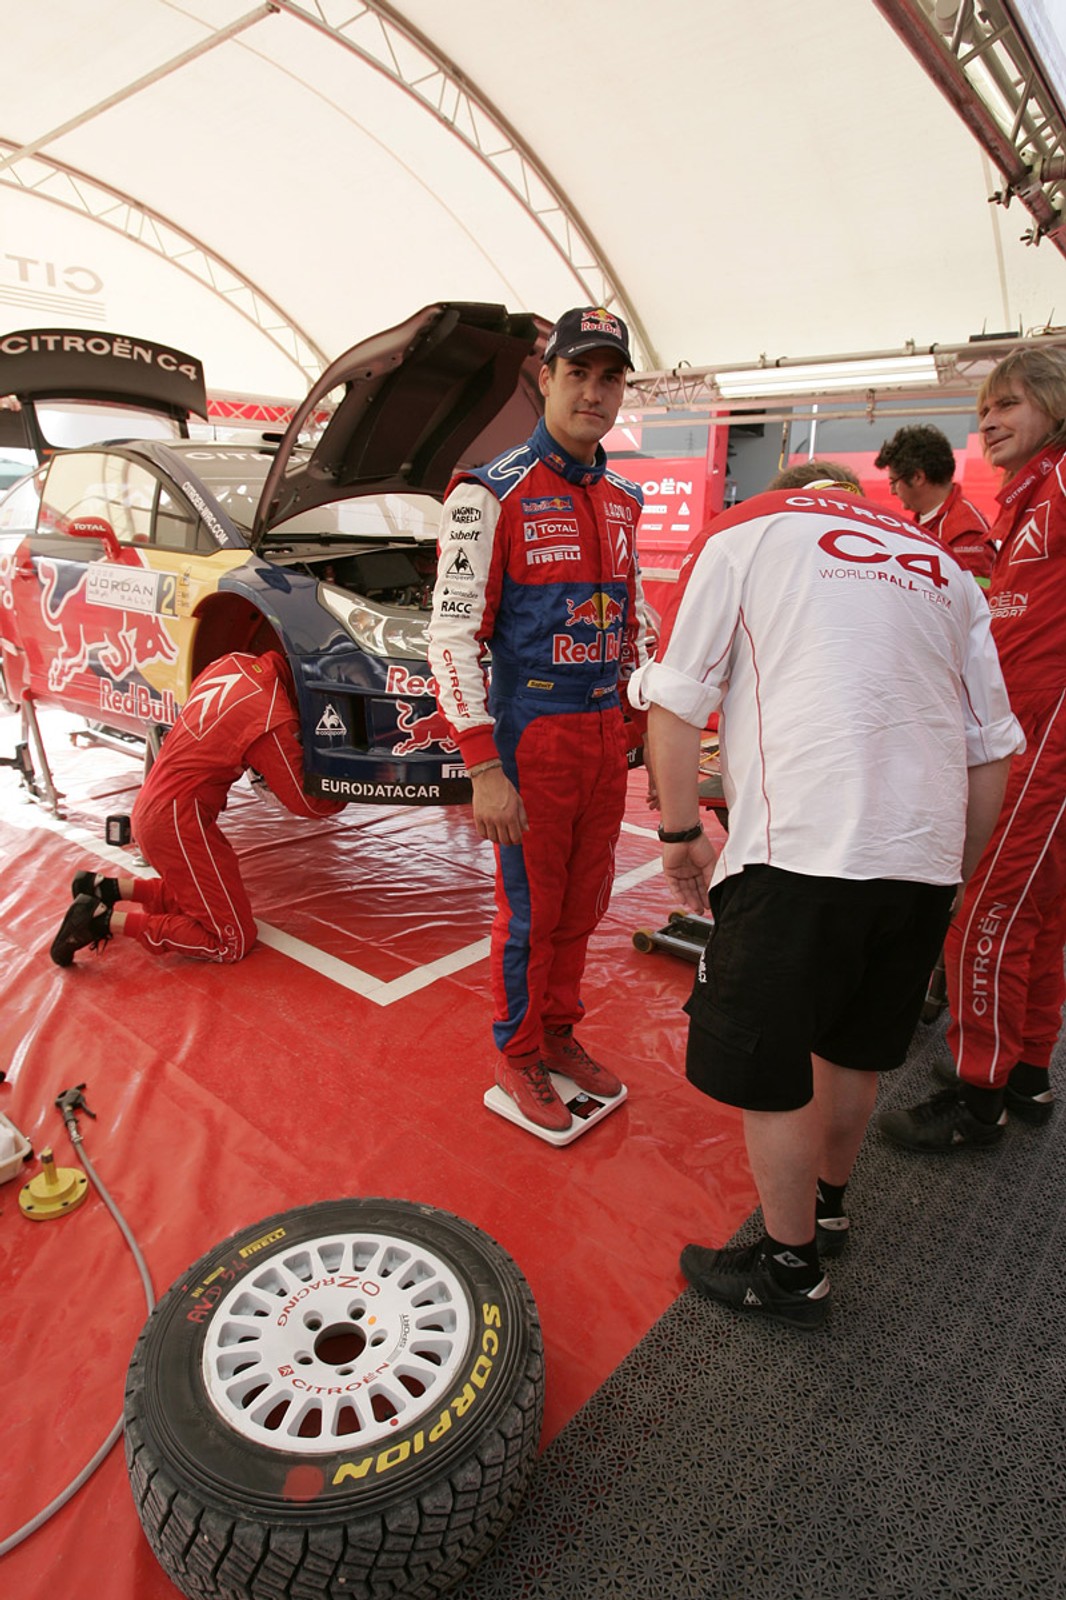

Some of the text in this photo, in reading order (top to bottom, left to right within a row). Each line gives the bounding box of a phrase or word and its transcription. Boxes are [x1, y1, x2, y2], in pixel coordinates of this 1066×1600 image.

[582, 321, 602, 331] Red
[1, 335, 197, 381] CITROËN C4
[74, 523, 106, 532] TOTAL
[537, 523, 577, 534] TOTAL
[526, 545, 581, 566] PIRELLI
[817, 529, 949, 589] C4
[89, 577, 154, 596] JORDAN
[161, 575, 176, 615] 2
[441, 600, 472, 614] RACC
[552, 631, 602, 664] Red
[100, 677, 176, 725] Red Bull
[321, 779, 440, 799] EURODATACAR
[972, 902, 1008, 1016] CITROËN
[239, 1228, 286, 1258] PIRELLI
[277, 1277, 335, 1327] RACING
[292, 1362, 390, 1395] CITROËN
[332, 1302, 502, 1485] SCORPION
